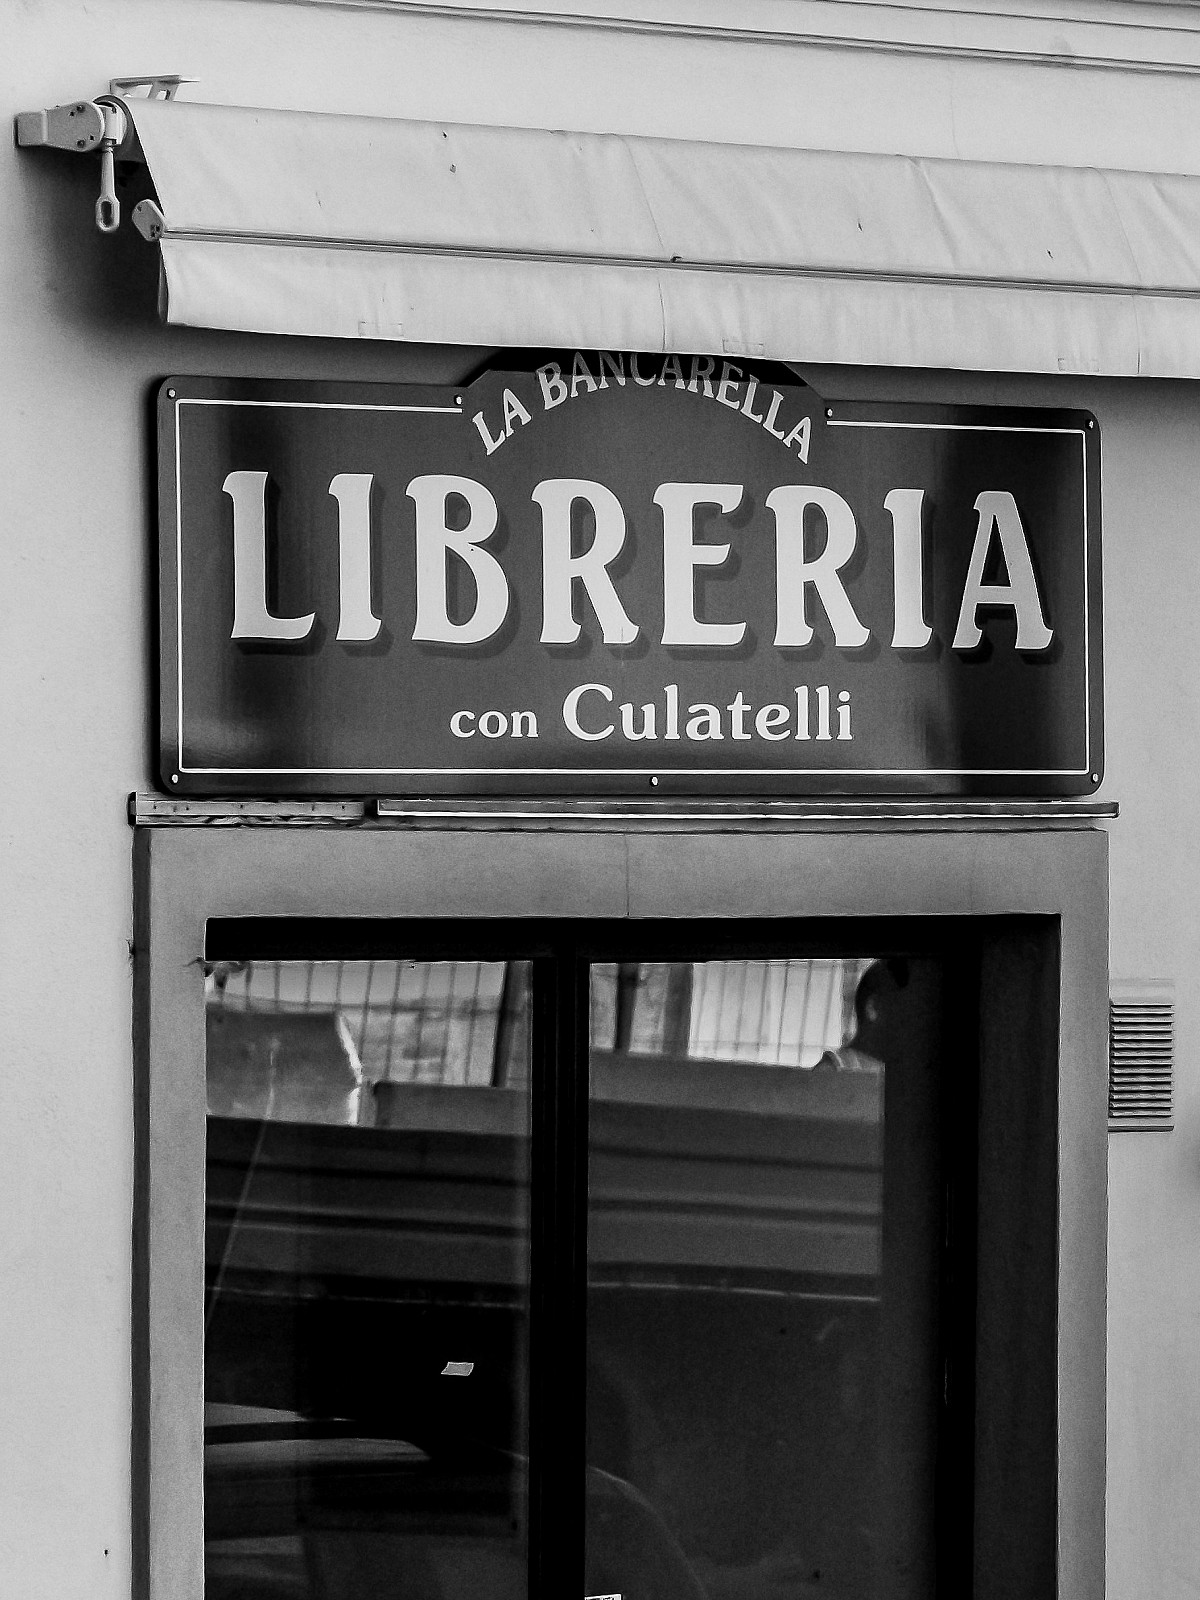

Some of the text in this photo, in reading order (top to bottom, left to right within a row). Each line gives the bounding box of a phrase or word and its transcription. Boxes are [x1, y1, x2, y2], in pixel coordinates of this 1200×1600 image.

[472, 351, 812, 465] LA BANCARELLA
[221, 470, 1054, 650] LIBRERIA
[449, 683, 853, 741] con Culatelli
